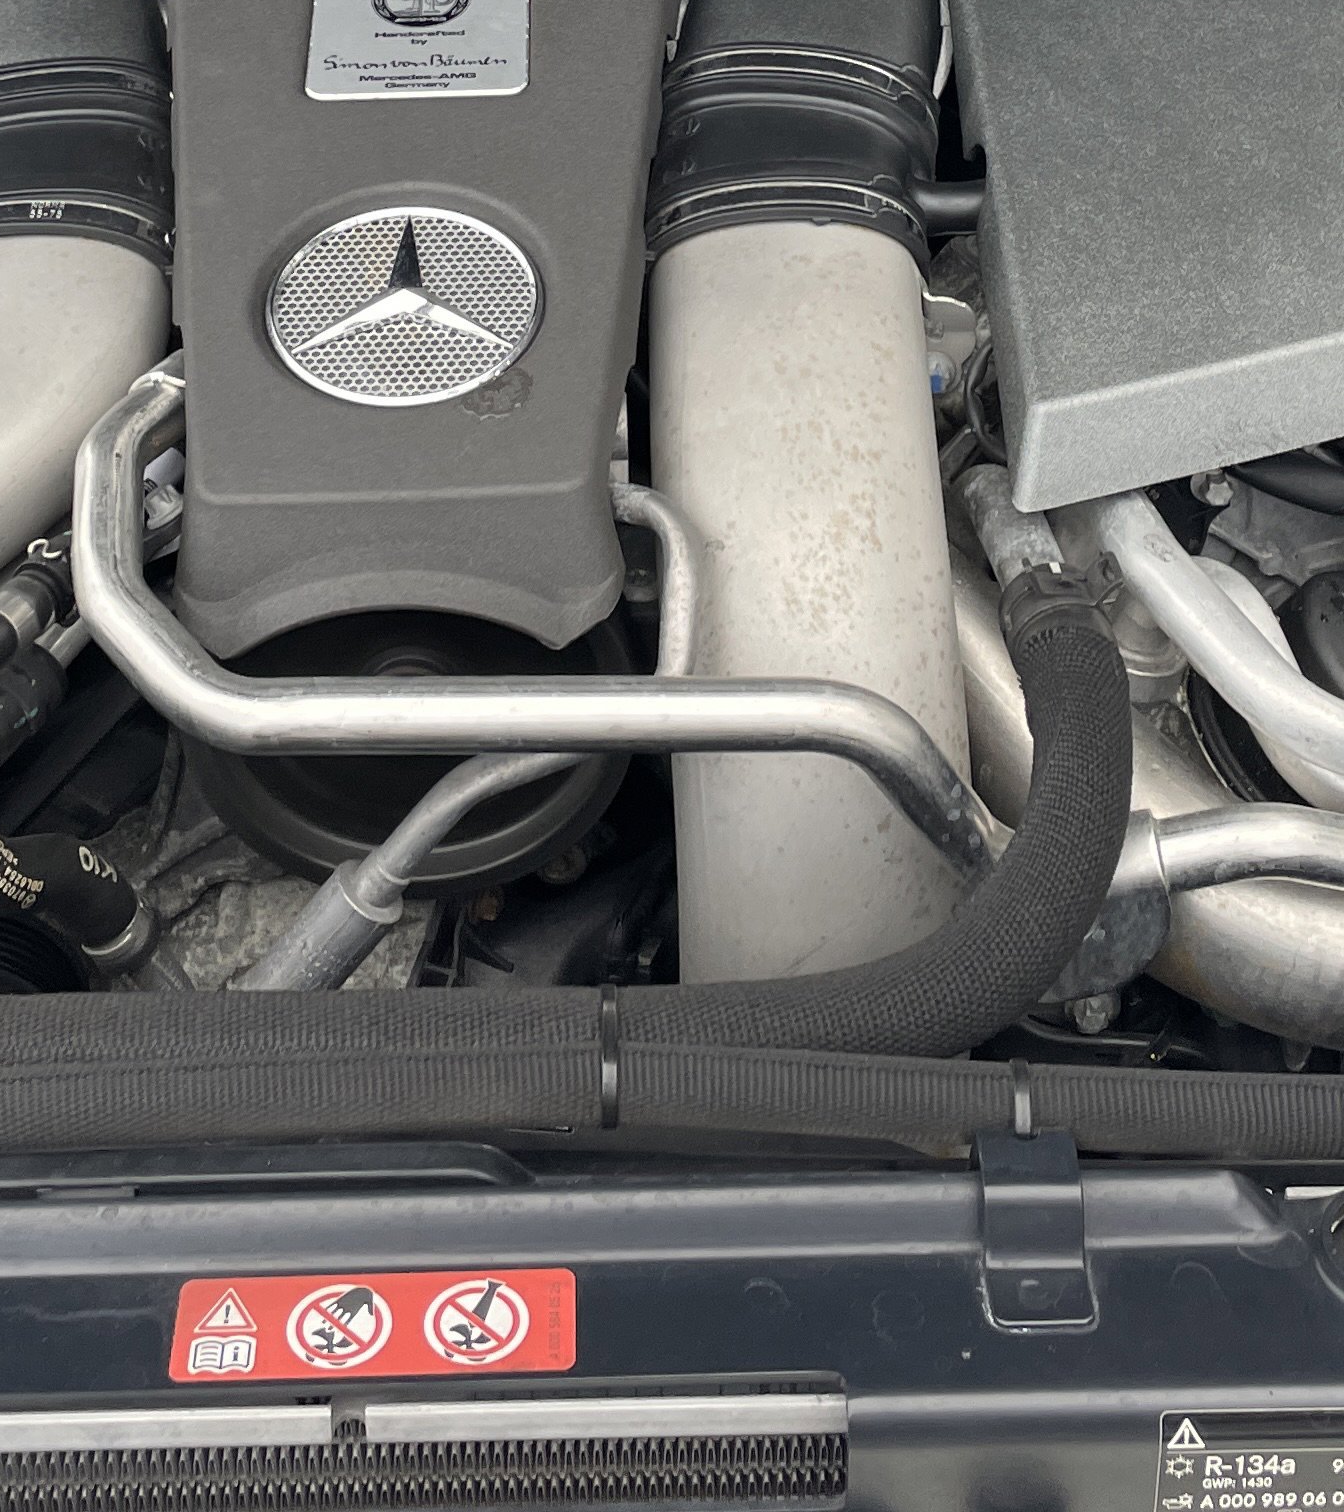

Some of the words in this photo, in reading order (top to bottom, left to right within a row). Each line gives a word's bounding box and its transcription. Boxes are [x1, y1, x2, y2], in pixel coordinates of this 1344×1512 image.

[374, 29, 466, 38] Handcrafted
[410, 38, 428, 46] by
[359, 72, 477, 82] Mercedes-AMG
[384, 81, 451, 89] Germany
[1205, 1454, 1296, 1476] R-134a
[1241, 1476, 1273, 1488] 1430
[1200, 1494, 1214, 1509] A
[1218, 1493, 1256, 1508] 000
[1261, 1491, 1298, 1508] 989
[1302, 1490, 1327, 1507] 06
